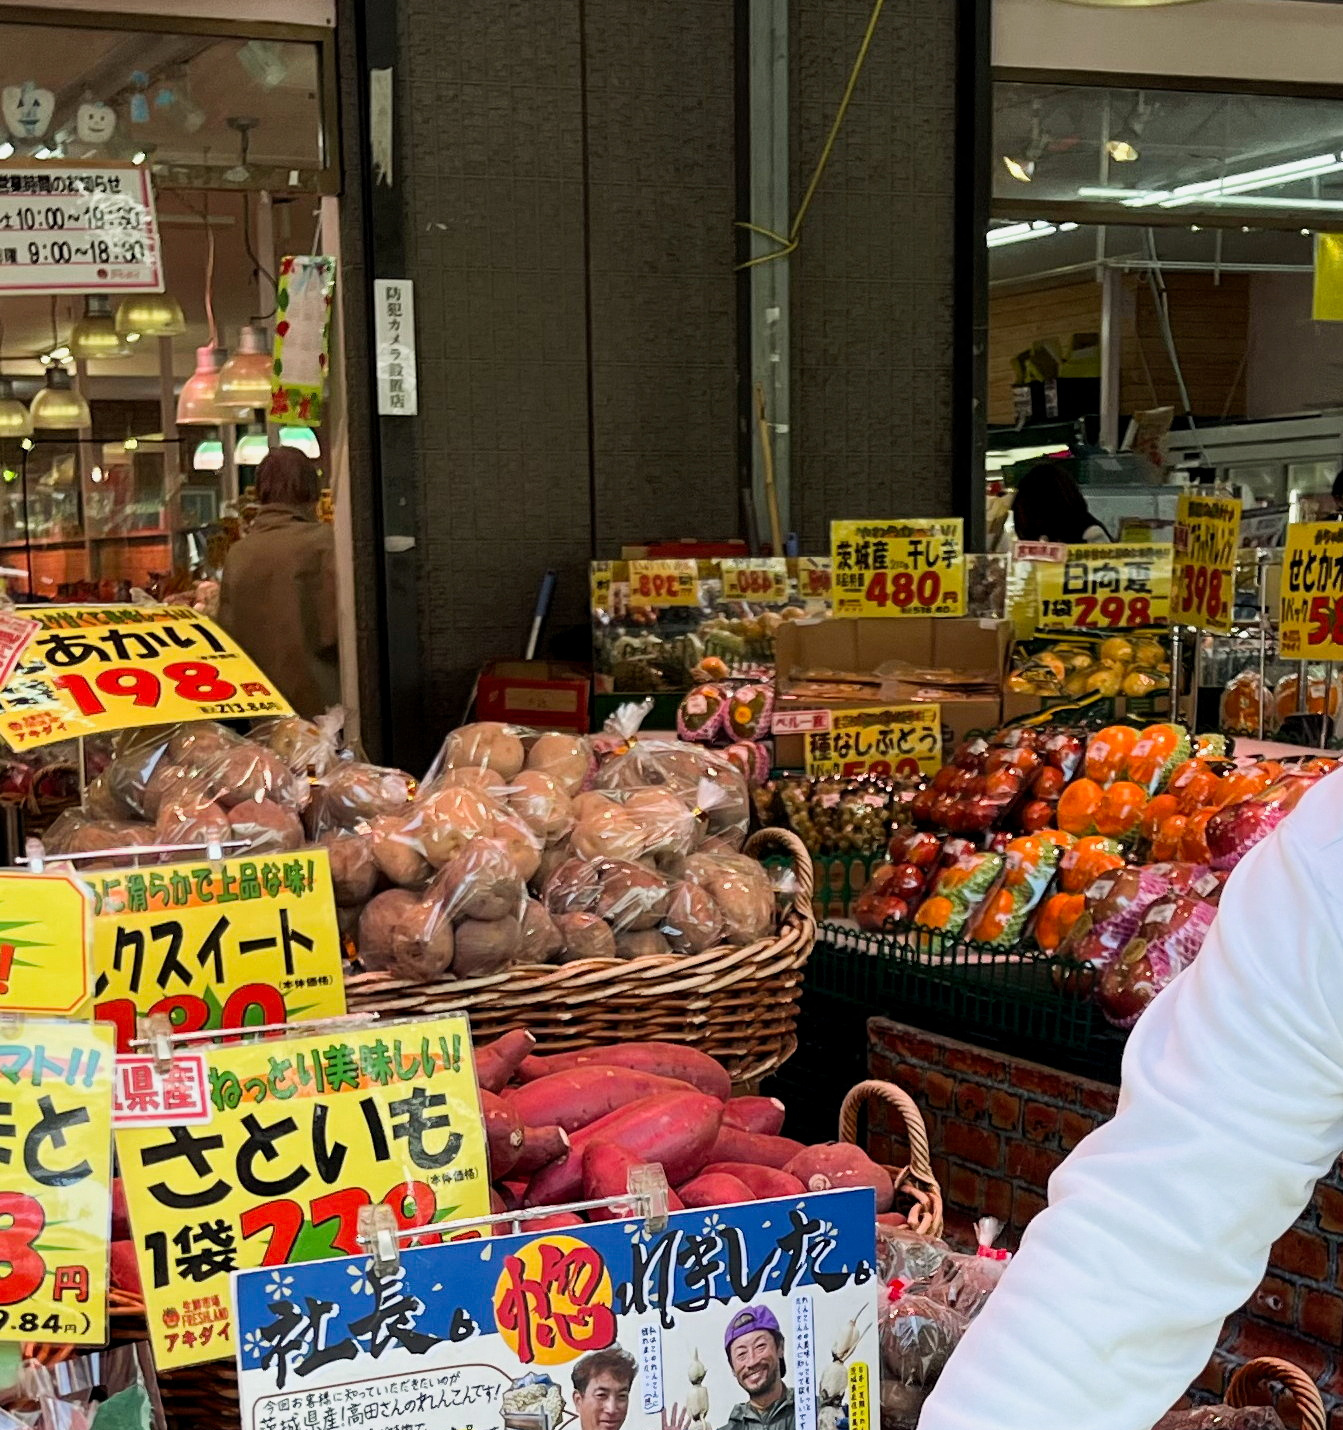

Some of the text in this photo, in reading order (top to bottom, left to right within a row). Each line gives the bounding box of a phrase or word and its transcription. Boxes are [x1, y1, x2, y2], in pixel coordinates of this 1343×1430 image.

[386, 286, 405, 408] 防犯カメラ設置店
[836, 541, 888, 570] 茨城産
[866, 570, 940, 608] 480
[943, 591, 959, 604] 円
[1074, 596, 1151, 628] 298
[1181, 565, 1223, 619] 398
[35, 623, 227, 667] あかり
[56, 660, 237, 717] 198
[242, 682, 271, 697] 円
[809, 727, 938, 761] 種なしぶどう
[95, 908, 314, 997] クスイート
[114, 1063, 197, 1110] 県産
[208, 1034, 462, 1112] ねっとり美味しい!
[139, 1086, 464, 1210] さといも
[144, 1219, 240, 1290] 1袋
[52, 1264, 90, 1304] 円
[163, 1320, 232, 1353] アキダイ
